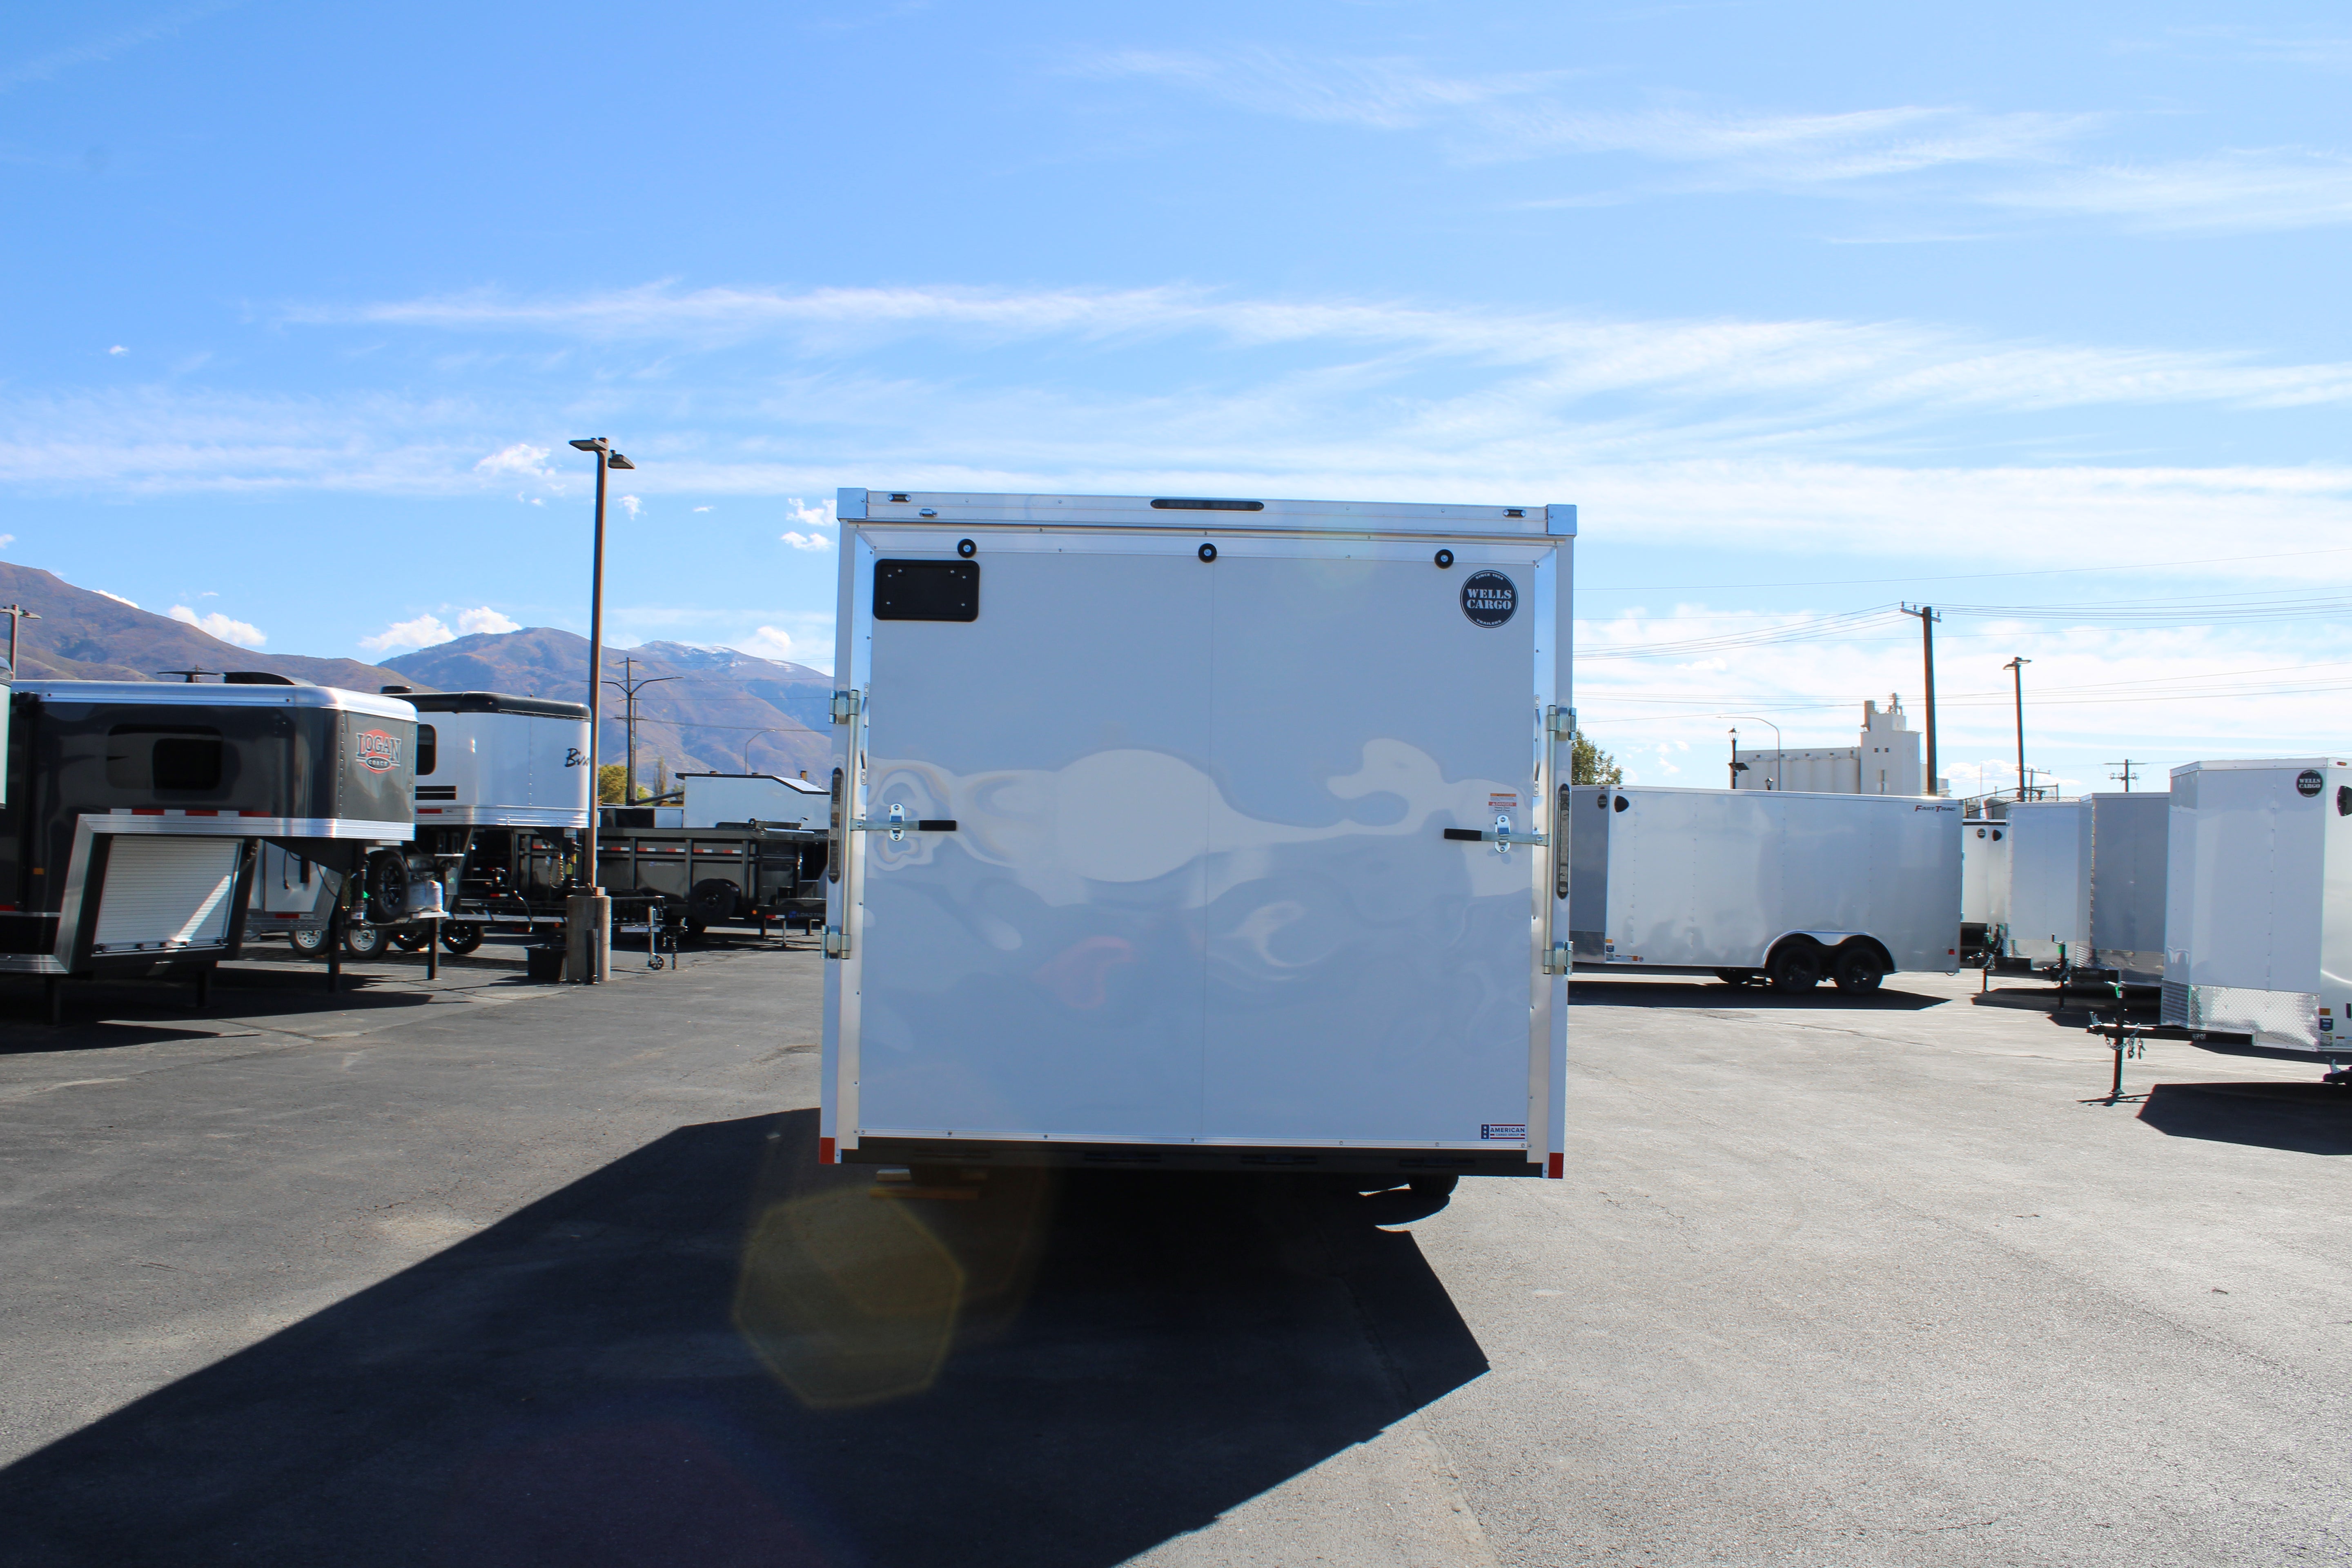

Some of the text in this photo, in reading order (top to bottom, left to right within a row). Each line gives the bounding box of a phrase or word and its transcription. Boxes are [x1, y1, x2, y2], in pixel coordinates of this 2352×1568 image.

[1467, 588, 1512, 599] WELLS
[1466, 599, 1512, 610] CARGO
[356, 733, 402, 763] LOGAN
